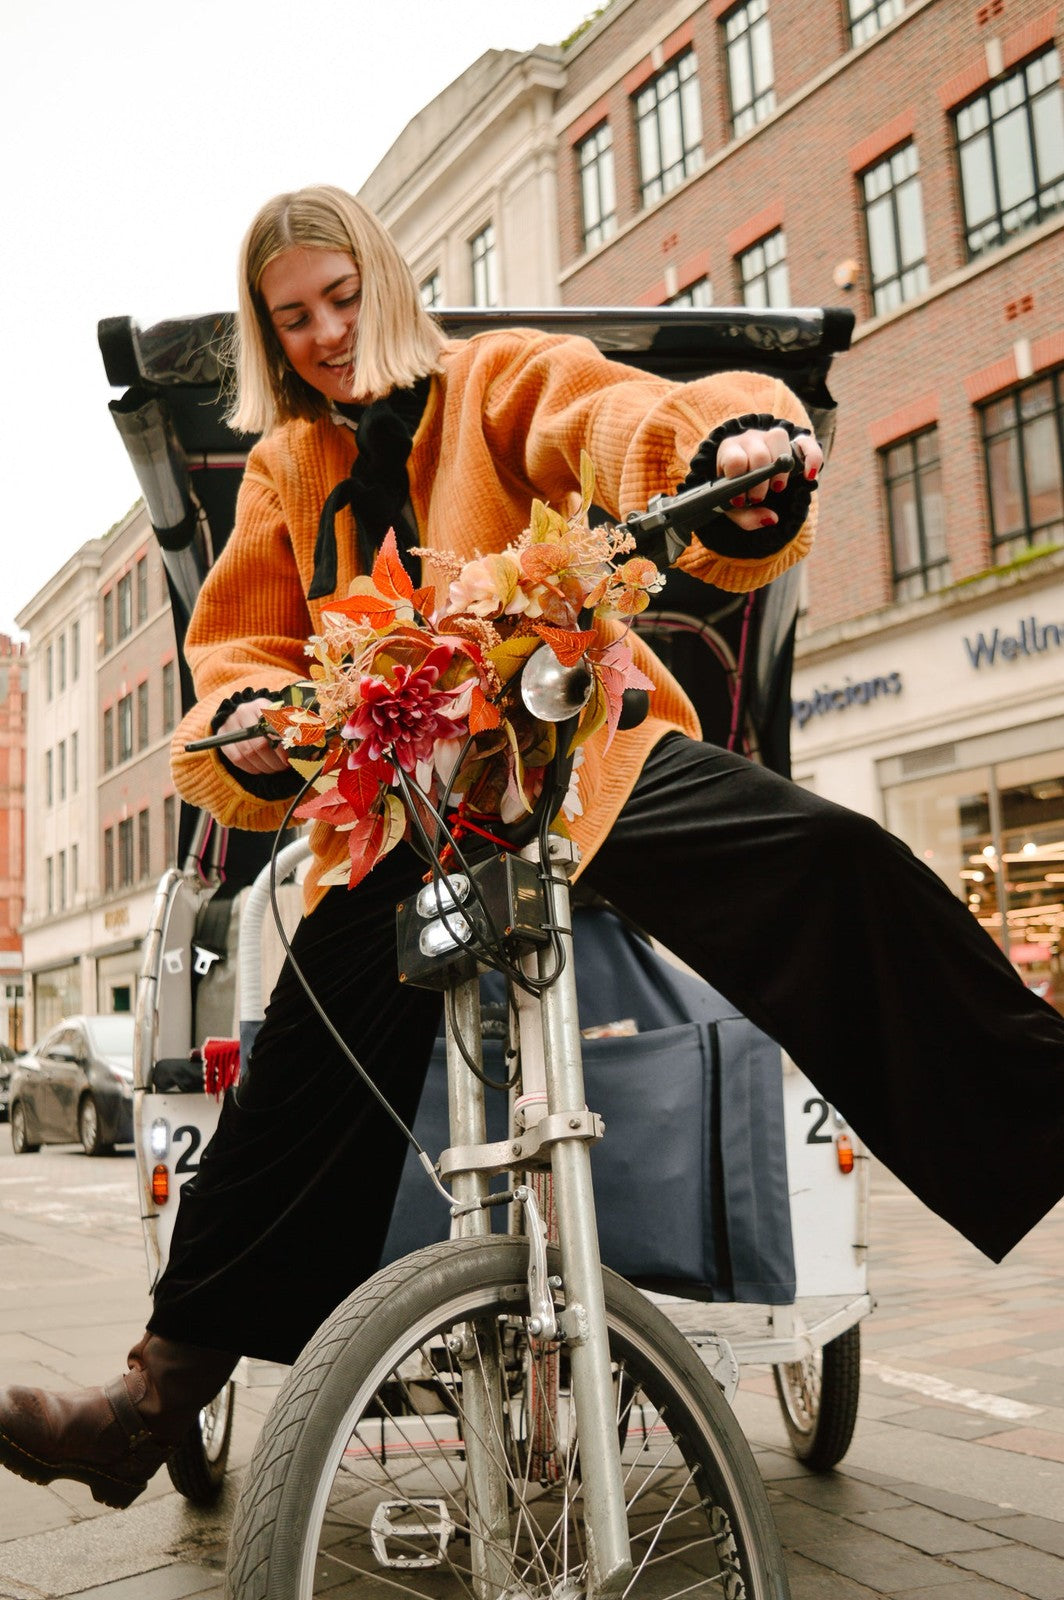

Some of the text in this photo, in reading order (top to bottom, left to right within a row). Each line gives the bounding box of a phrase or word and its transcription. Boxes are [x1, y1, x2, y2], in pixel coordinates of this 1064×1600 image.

[790, 616, 1064, 728] pticians Welln
[803, 1098, 833, 1145] 2
[172, 1125, 202, 1175] 2
